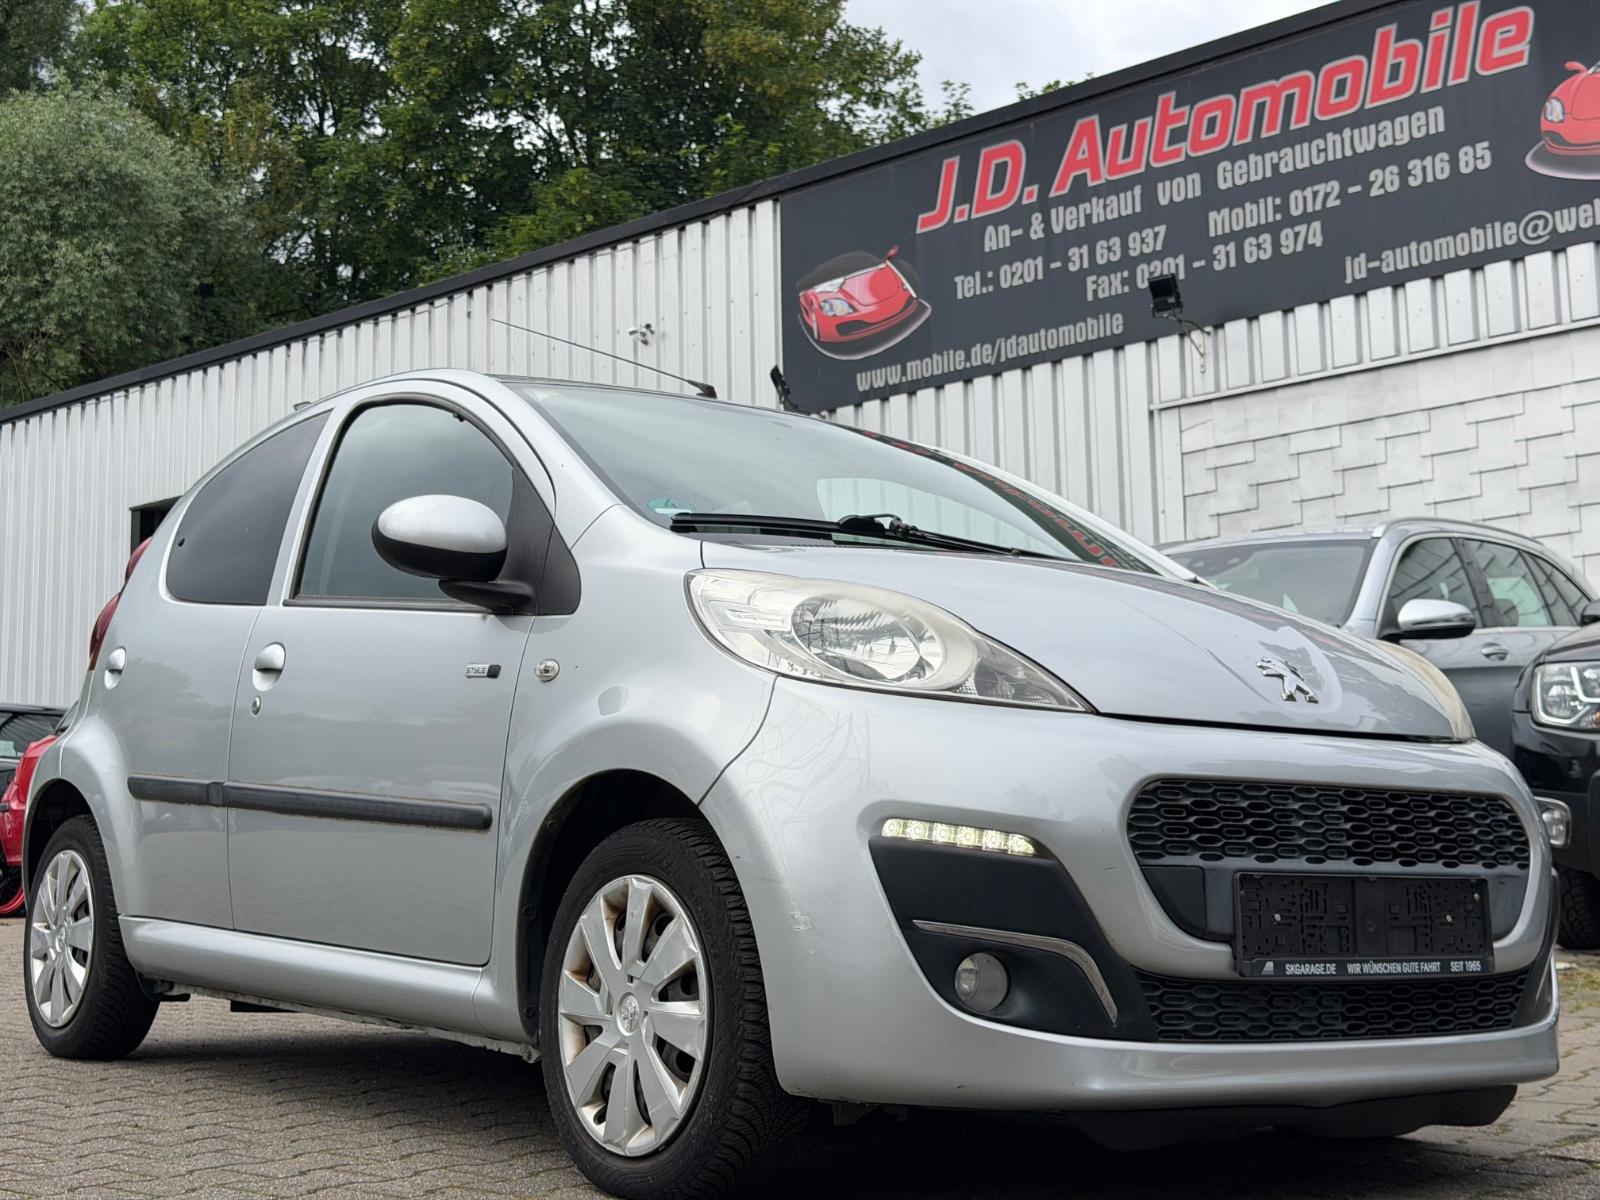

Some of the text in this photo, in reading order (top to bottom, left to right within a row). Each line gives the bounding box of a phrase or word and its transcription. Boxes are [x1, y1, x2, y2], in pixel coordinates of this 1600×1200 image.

[916, 0, 1535, 234] J.D. Automobile
[954, 272, 994, 300] Tel.:
[999, 257, 1043, 289] 0201
[1068, 245, 1089, 273] 31
[1095, 237, 1121, 264] 63
[1128, 225, 1167, 257] 937
[1208, 196, 1282, 237] Mobil:
[1289, 180, 1341, 217] 0172
[1369, 165, 1399, 197] 26
[1407, 151, 1450, 188] 316
[1458, 141, 1492, 174] 85
[984, 106, 1445, 252] An- & Verkauf von Gebrauchtwagen
[1086, 270, 1130, 301] Fax:
[1213, 241, 1236, 271] 31
[1243, 233, 1272, 263] 63
[1280, 220, 1324, 257] 974
[856, 312, 1124, 392] www.mobile.de/jdautomobile
[1285, 963, 1337, 975] SKGARAGE.DE
[1347, 962, 1361, 974] WIR
[1362, 960, 1400, 974] WÜNSCHEN
[1402, 962, 1419, 974] GUTE
[1420, 961, 1440, 973] FAHRT
[1450, 961, 1463, 972] SEIT
